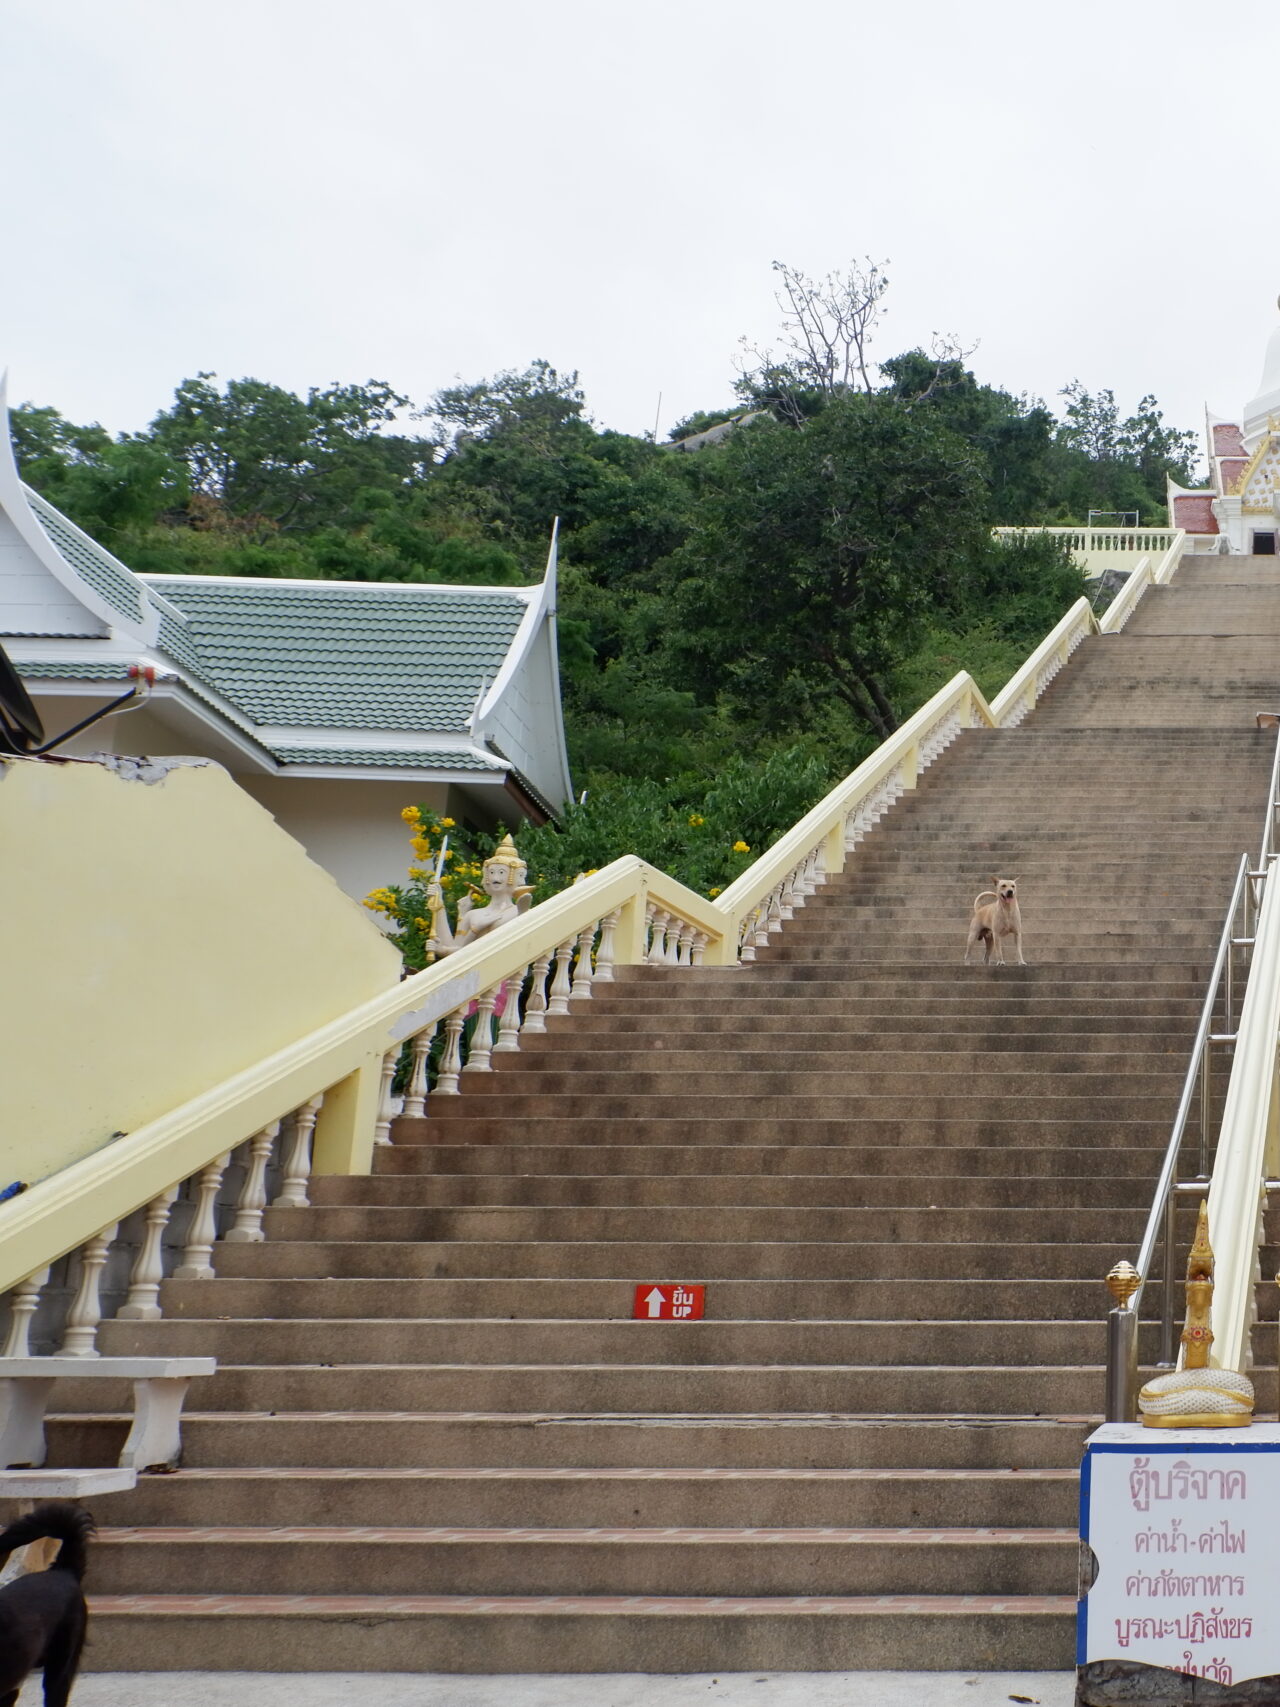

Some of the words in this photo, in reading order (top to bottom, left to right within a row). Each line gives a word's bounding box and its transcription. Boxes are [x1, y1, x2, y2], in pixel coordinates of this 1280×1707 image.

[672, 1306, 692, 1318] UP
[1128, 1457, 1247, 1512] ตู้บริจาค
[1125, 1568, 1246, 1597] ค่าภัตตาหาร
